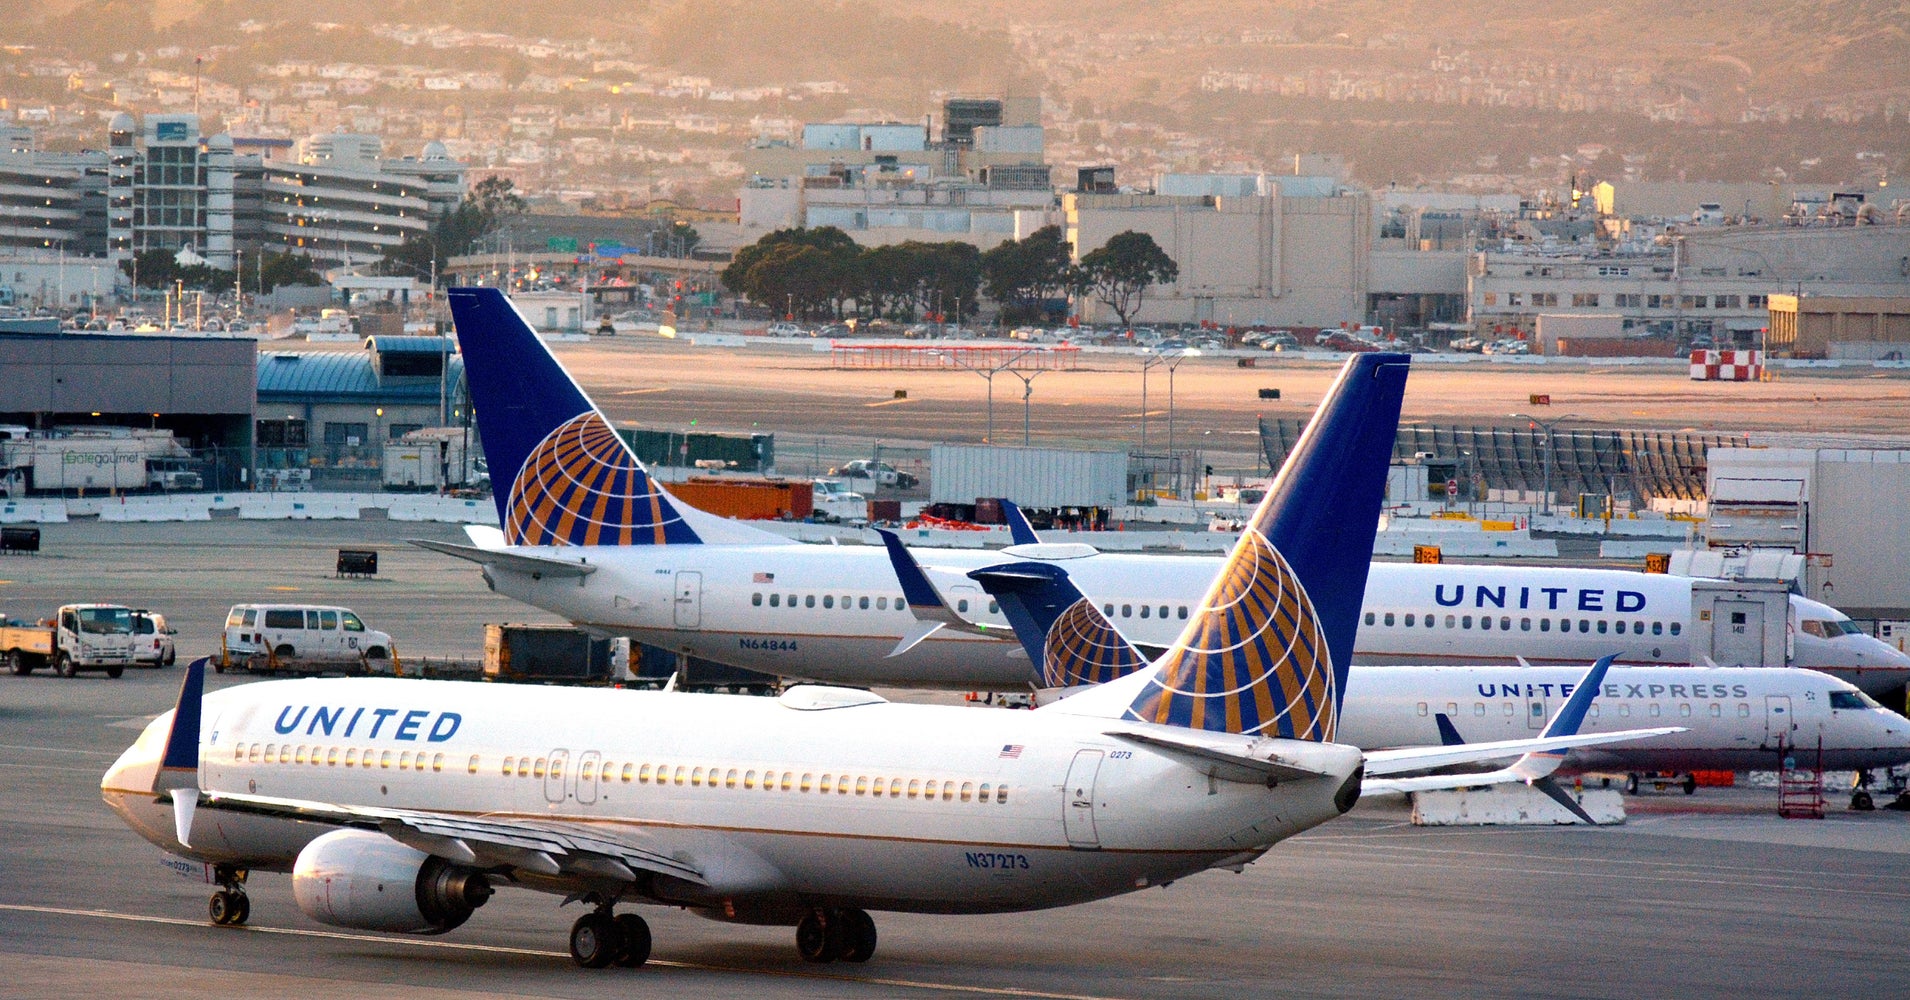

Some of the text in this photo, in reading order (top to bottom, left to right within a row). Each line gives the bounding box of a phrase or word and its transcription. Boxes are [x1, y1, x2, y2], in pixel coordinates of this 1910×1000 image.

[1435, 584, 1646, 612] UNITED
[739, 639, 798, 651] N64844
[274, 705, 462, 742] UNITED
[1110, 751, 1132, 760] 0273
[965, 852, 1030, 869] N37273
